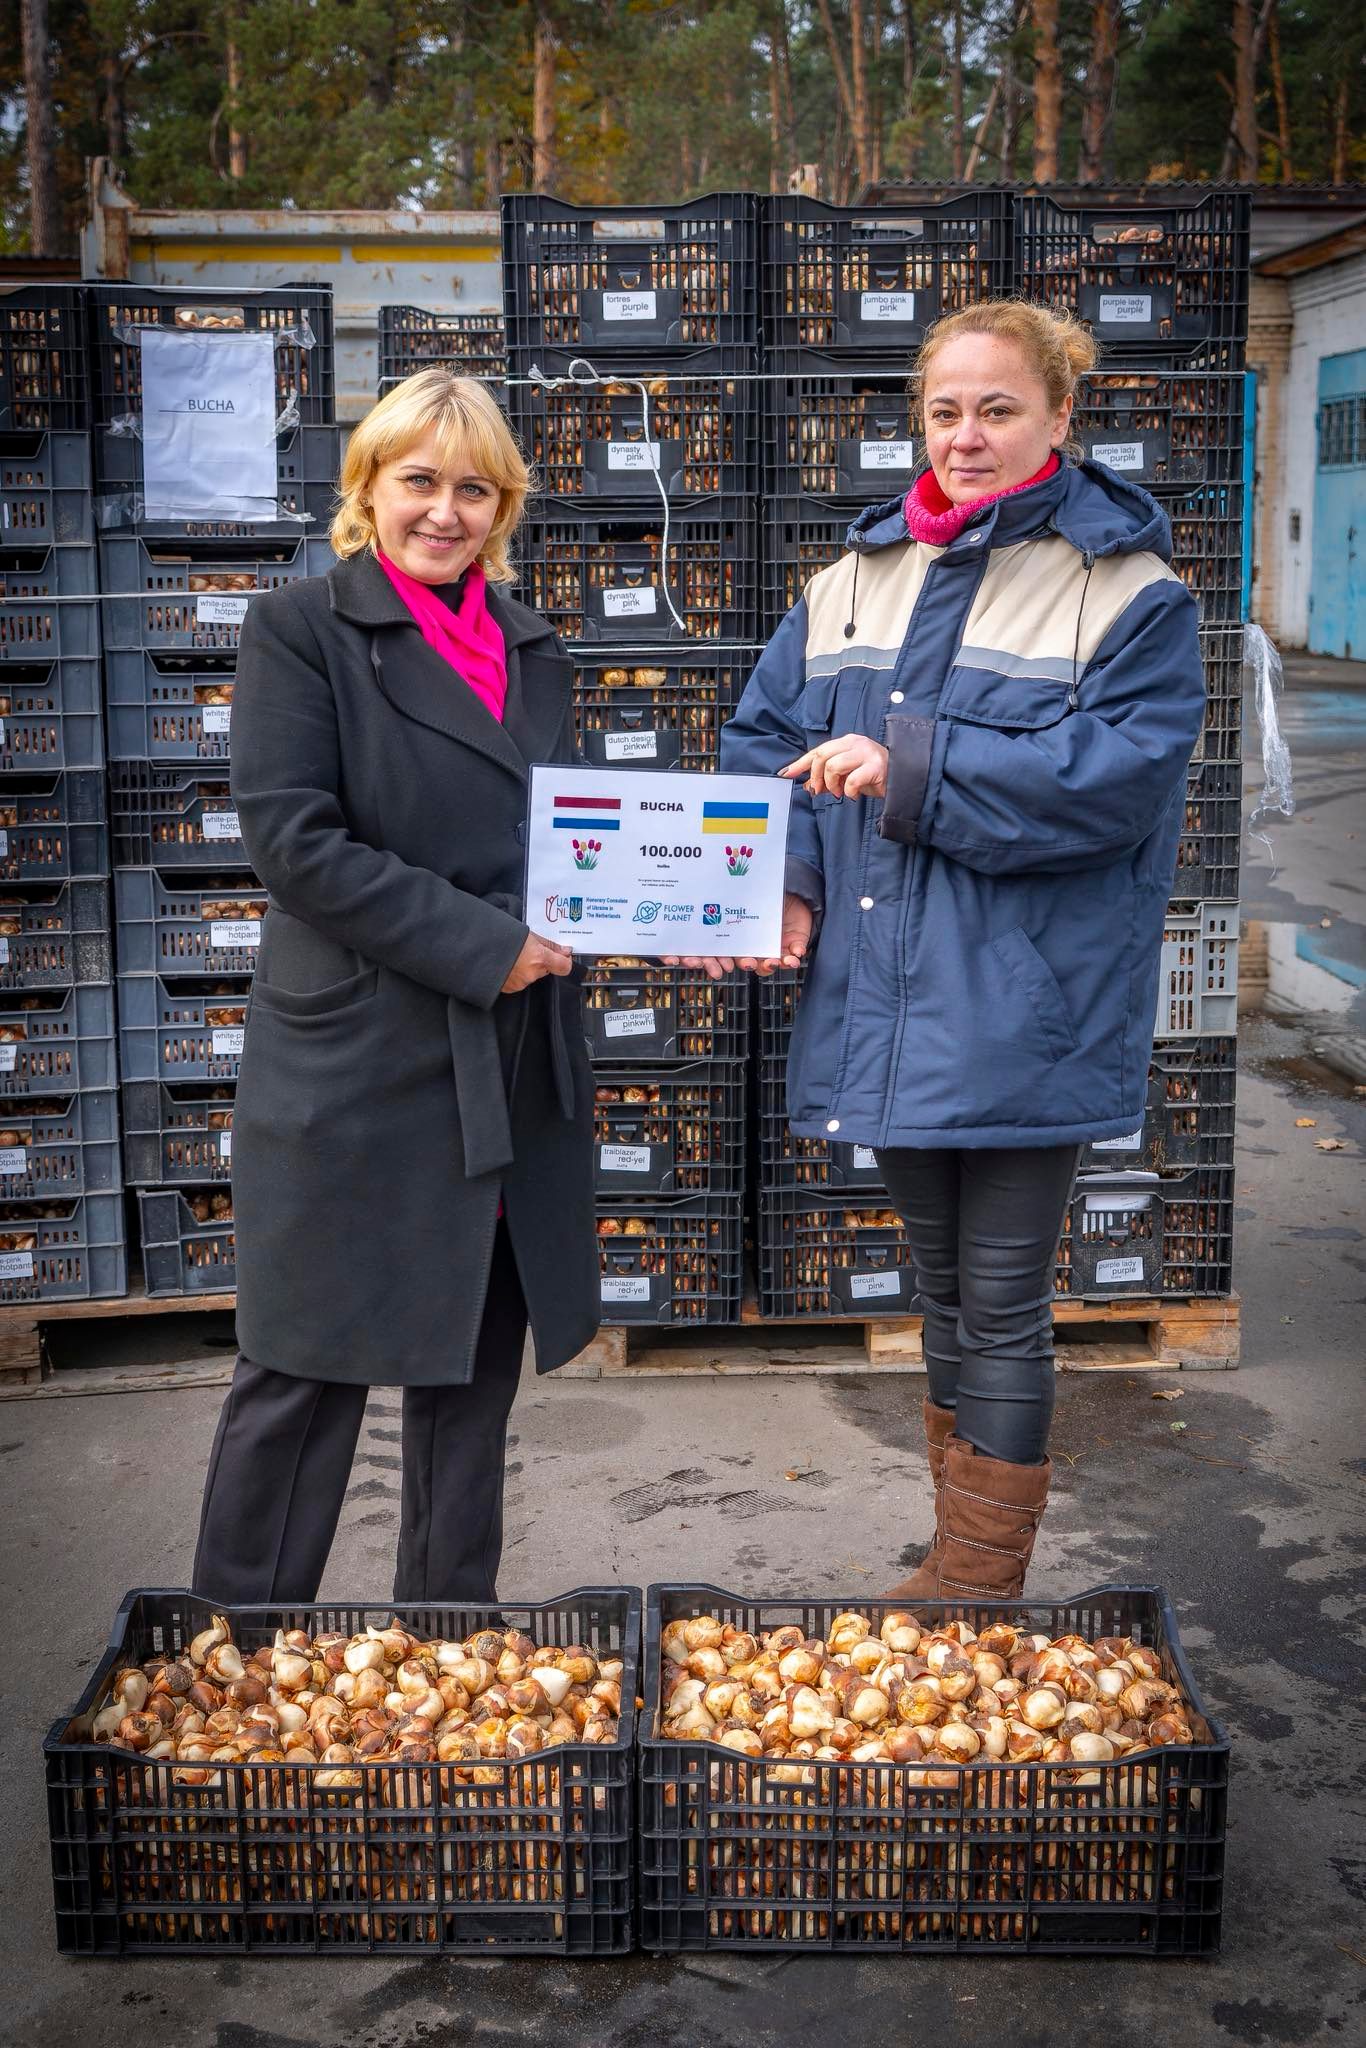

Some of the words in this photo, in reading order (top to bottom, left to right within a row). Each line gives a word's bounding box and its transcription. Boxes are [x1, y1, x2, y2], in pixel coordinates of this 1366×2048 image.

[864, 296, 888, 304] jumbo
[890, 296, 906, 304] pink
[622, 303, 649, 312] purple
[188, 400, 234, 410] BUCHA
[611, 446, 640, 454] dynasty
[864, 445, 887, 453] jumbo
[889, 444, 905, 452] pink
[1120, 447, 1136, 455] lady
[626, 453, 644, 461] pink
[607, 592, 636, 601] dynasty
[640, 801, 684, 812] BUCHA
[640, 845, 702, 858] 100.000
[557, 897, 568, 907] UA
[557, 908, 568, 918] NL
[608, 1013, 628, 1022] dutch
[618, 1156, 645, 1164] red-yel
[1099, 1261, 1120, 1270] purple
[1112, 1267, 1136, 1275] purple
[868, 1282, 885, 1290] pink
